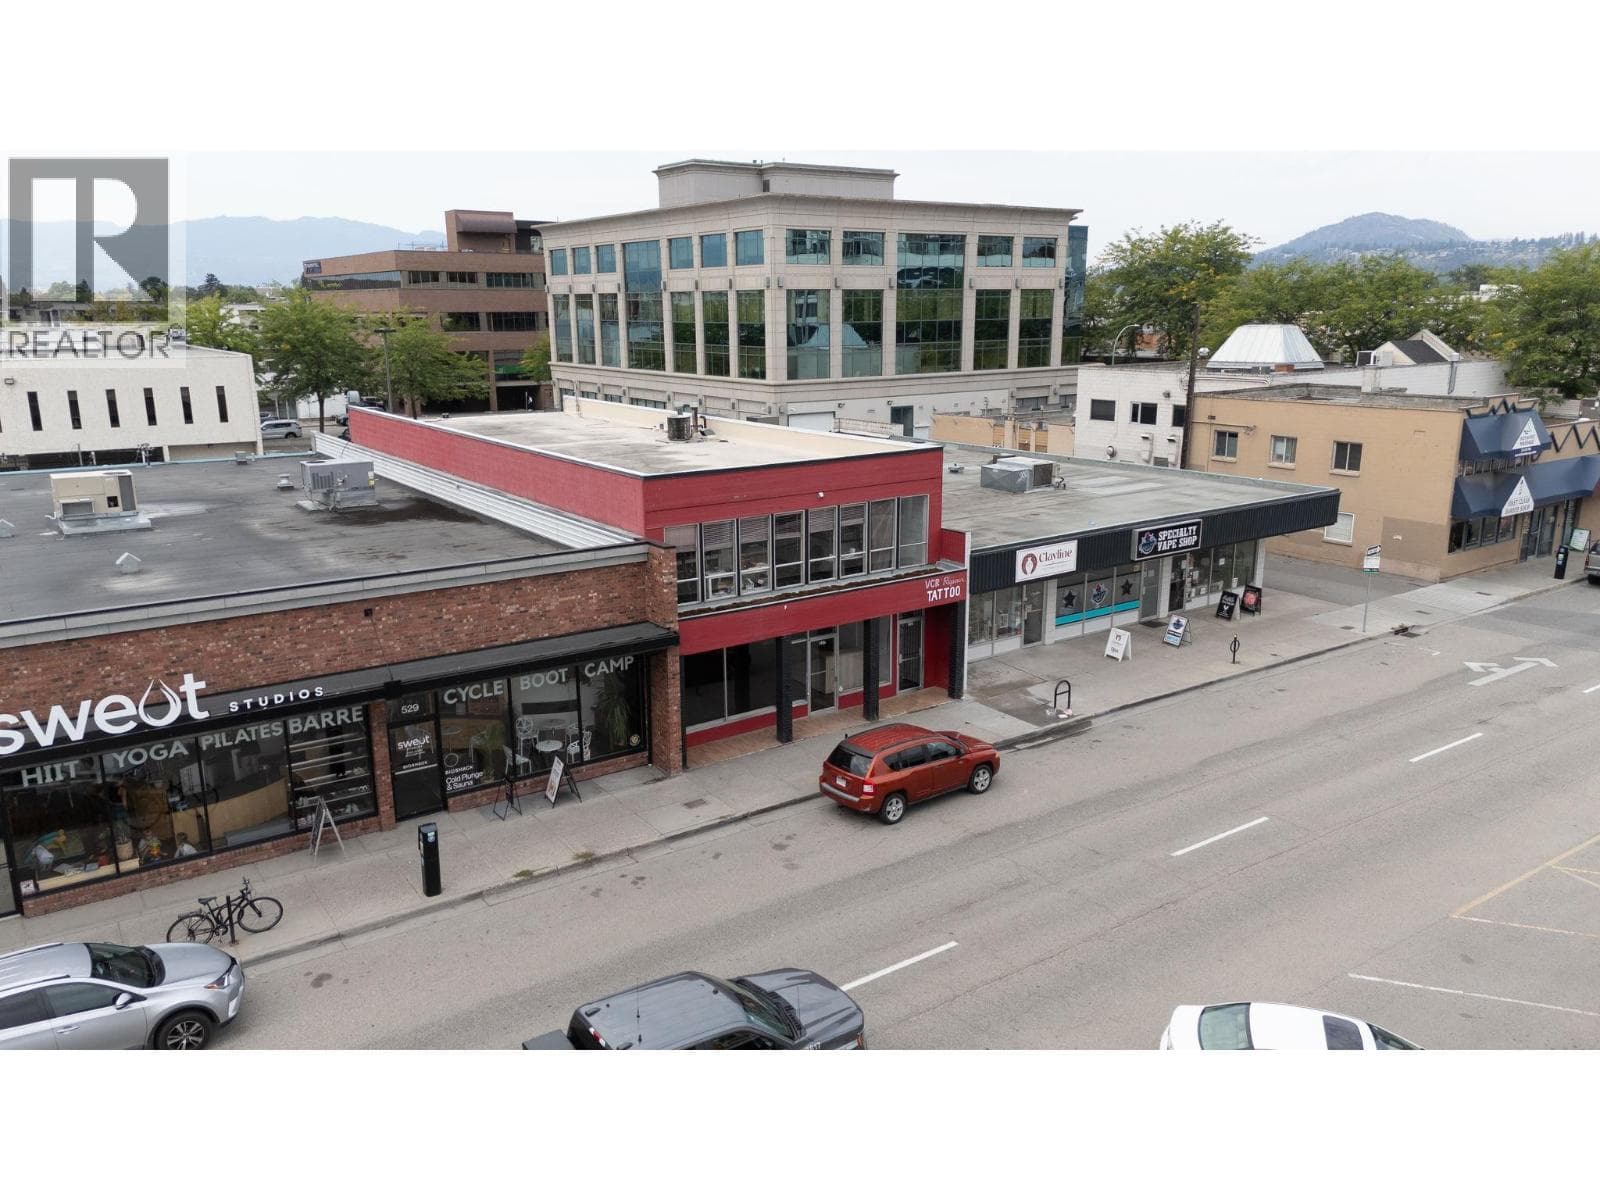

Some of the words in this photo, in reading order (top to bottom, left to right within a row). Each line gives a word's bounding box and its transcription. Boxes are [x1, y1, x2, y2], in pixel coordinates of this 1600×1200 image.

[1158, 526, 1198, 541] SPECIALTY
[1157, 539, 1178, 552] VAPE
[1178, 535, 1198, 547] SHOP
[926, 586, 961, 602] TATTOO
[443, 680, 504, 704] CYCLE
[520, 668, 569, 690] BOOT
[584, 656, 634, 678] CAMP
[229, 686, 324, 712] STUDIOS
[401, 703, 420, 714] 529
[21, 760, 80, 788] HIIT
[112, 740, 189, 769] YOGA
[201, 722, 283, 751] PILATES
[288, 705, 364, 735] BARRE
[445, 775, 461, 785] Cold
[461, 771, 484, 781] Plunge
